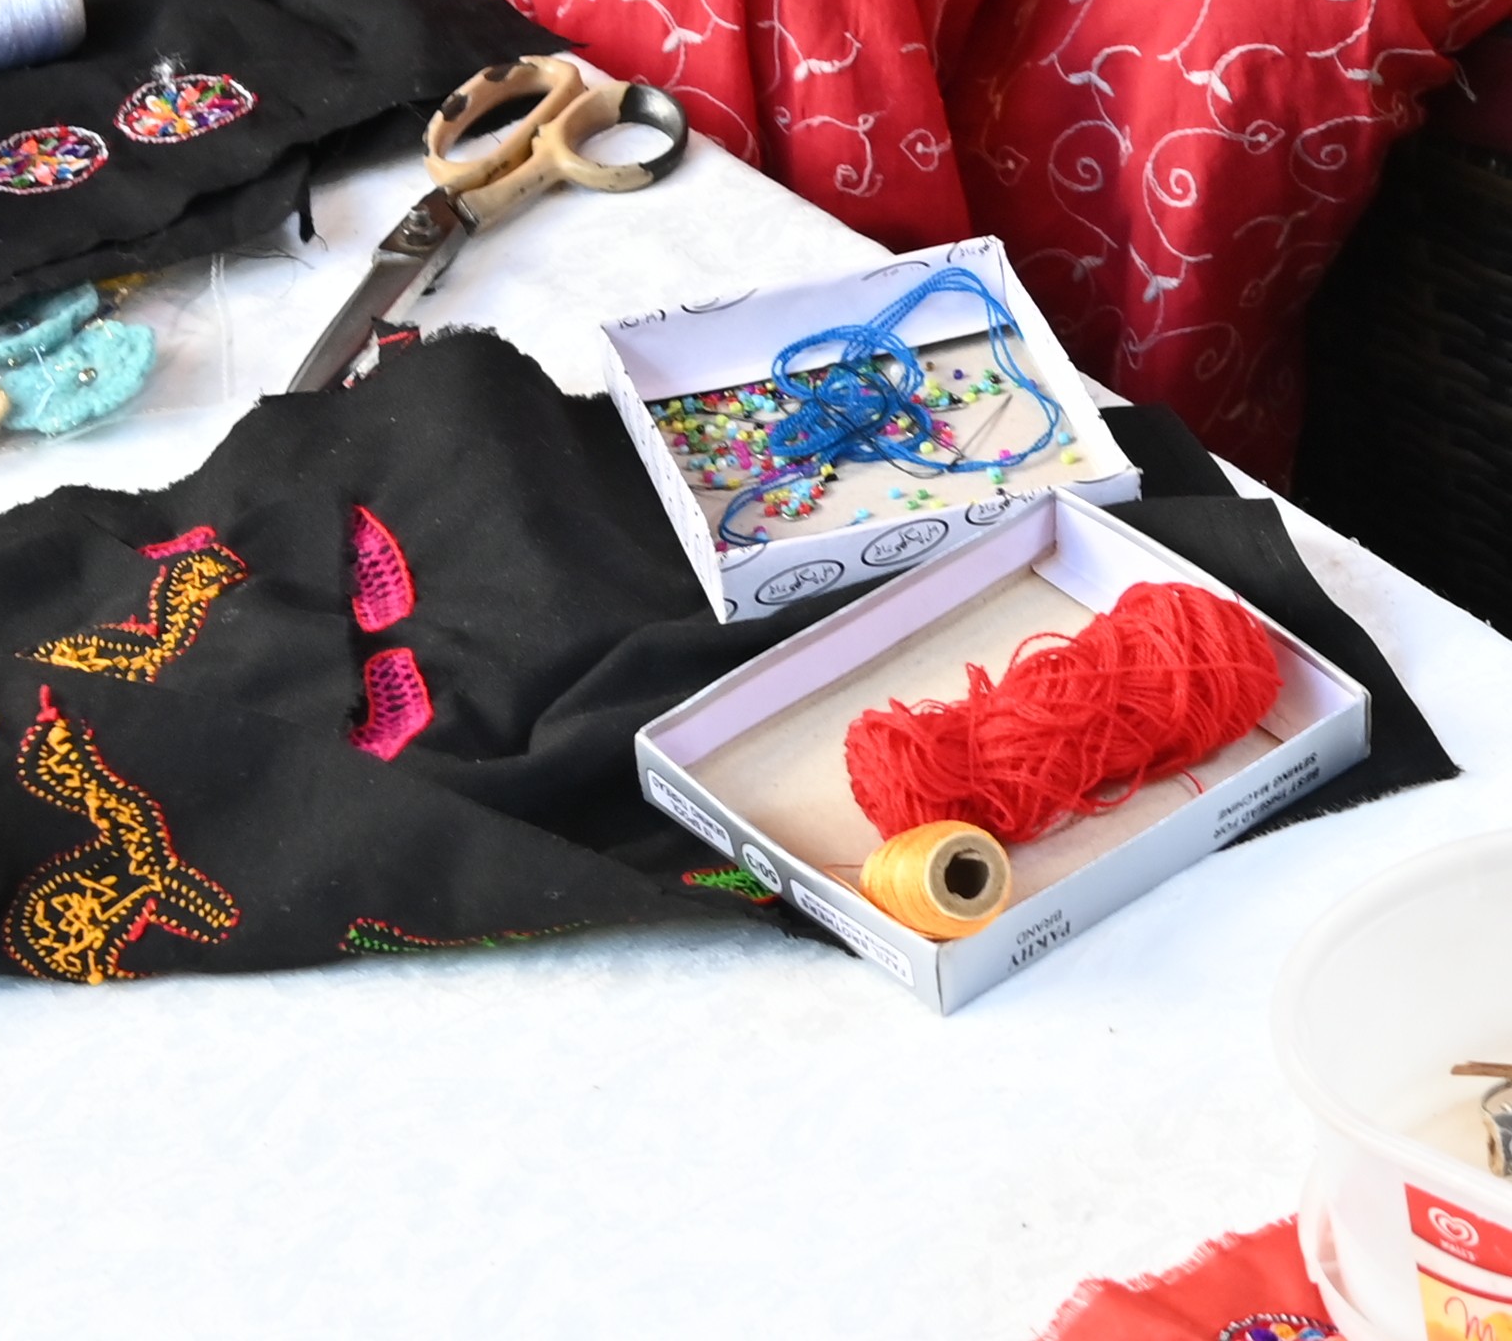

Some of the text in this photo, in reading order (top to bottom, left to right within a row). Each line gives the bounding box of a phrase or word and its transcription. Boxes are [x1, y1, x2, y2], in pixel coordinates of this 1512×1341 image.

[1217, 782, 1270, 821] MACHINE
[1213, 817, 1239, 840] FOR
[799, 897, 870, 951] BROTHERS
[1007, 909, 1070, 971] PAKHY BRAND
